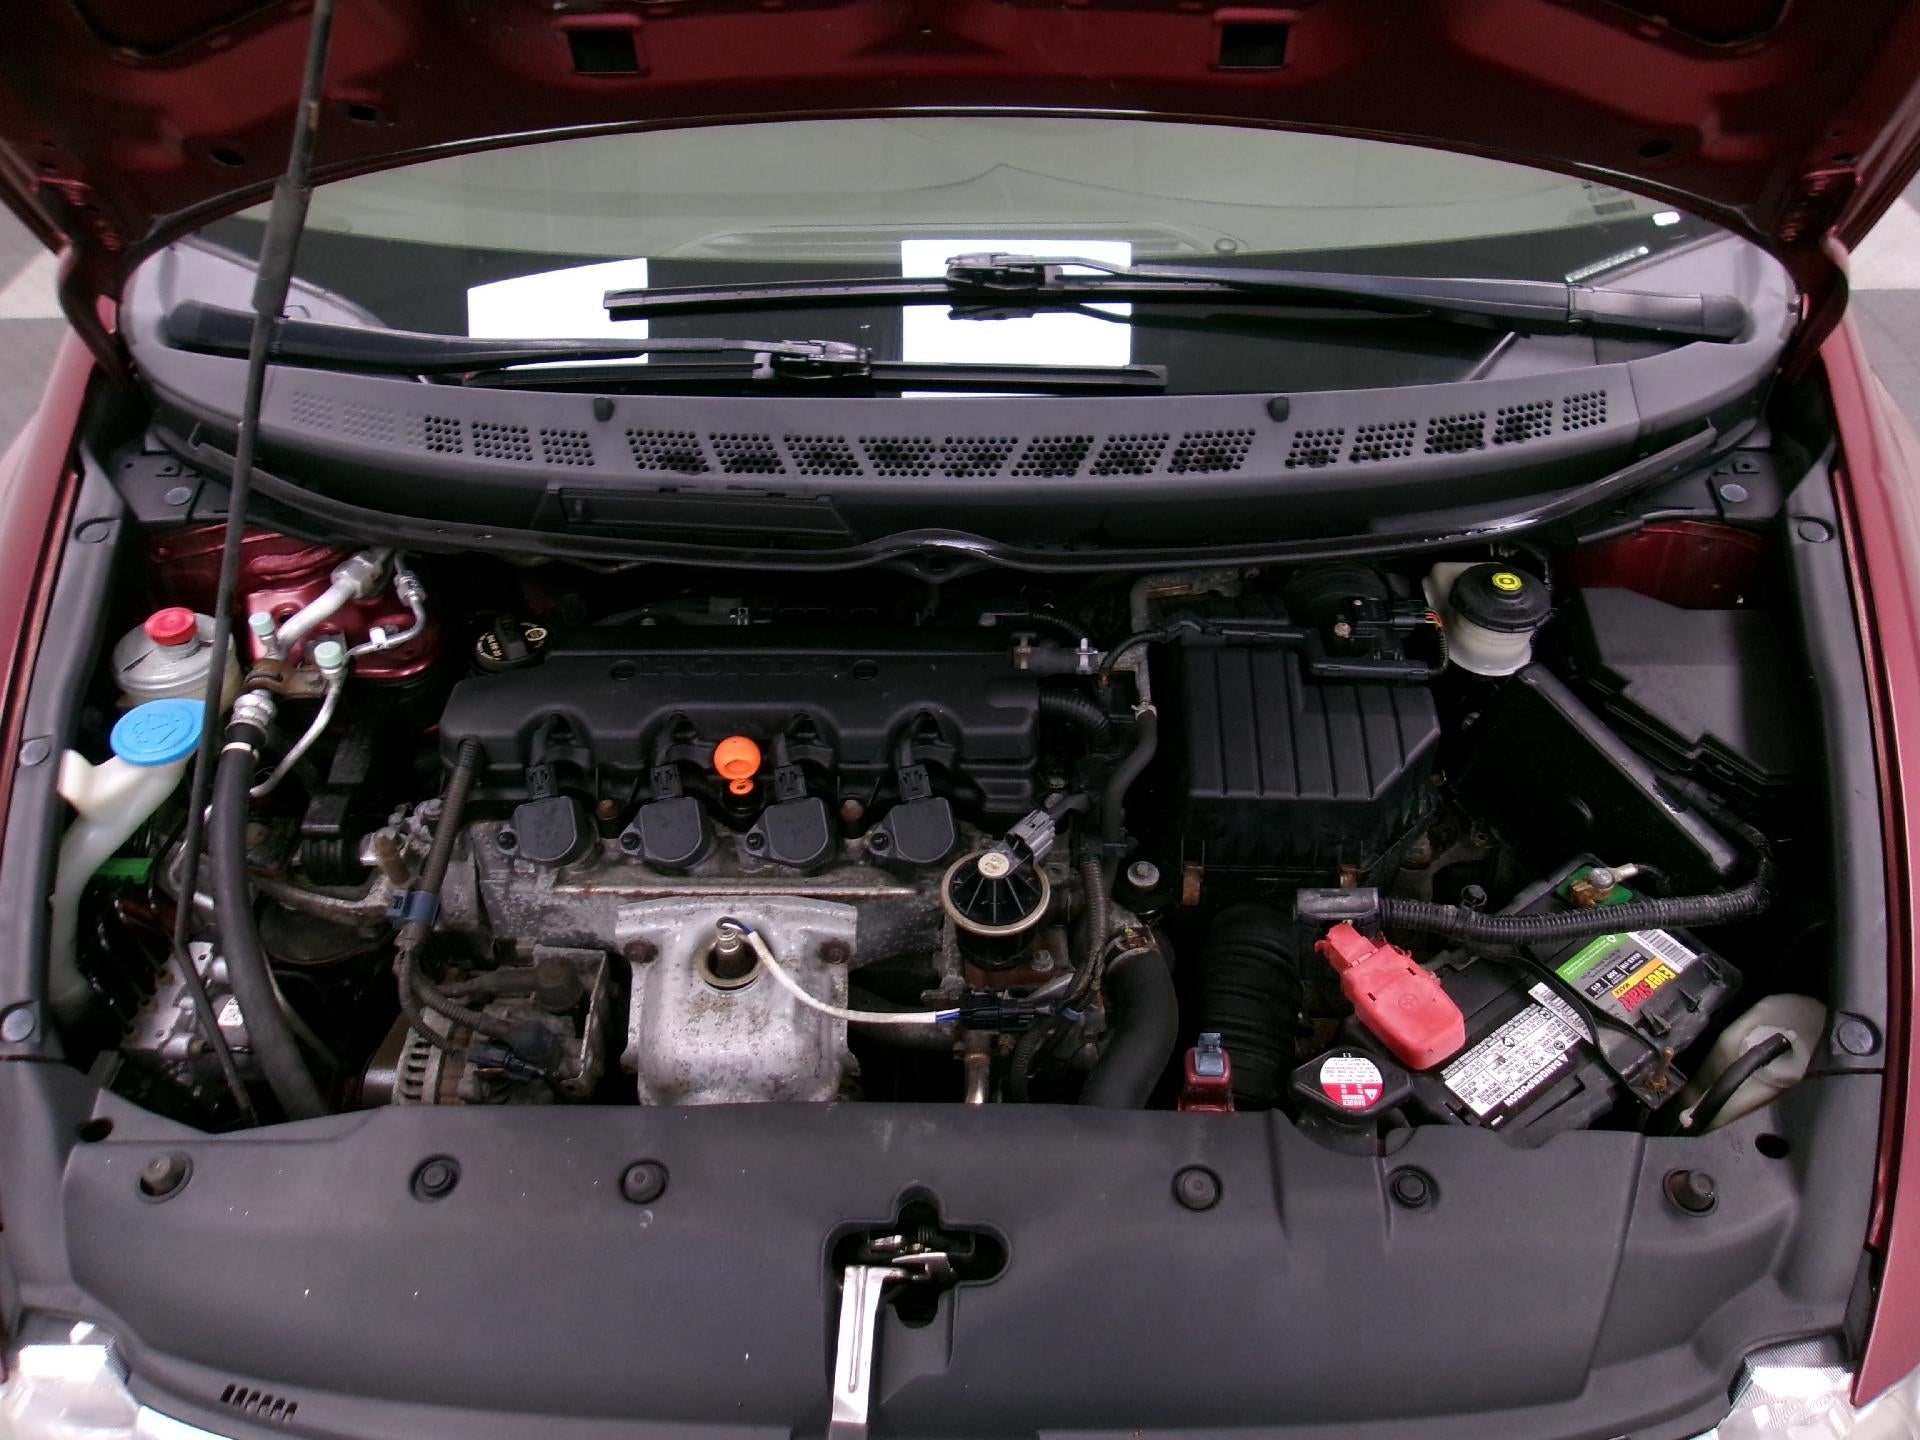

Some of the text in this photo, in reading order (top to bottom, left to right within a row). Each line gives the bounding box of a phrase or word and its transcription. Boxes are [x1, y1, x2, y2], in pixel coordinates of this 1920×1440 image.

[1614, 982, 1630, 995] MAXX
[1617, 964, 1677, 1013] EverStart
[1502, 1057, 1562, 1106] DANGER/POISON
